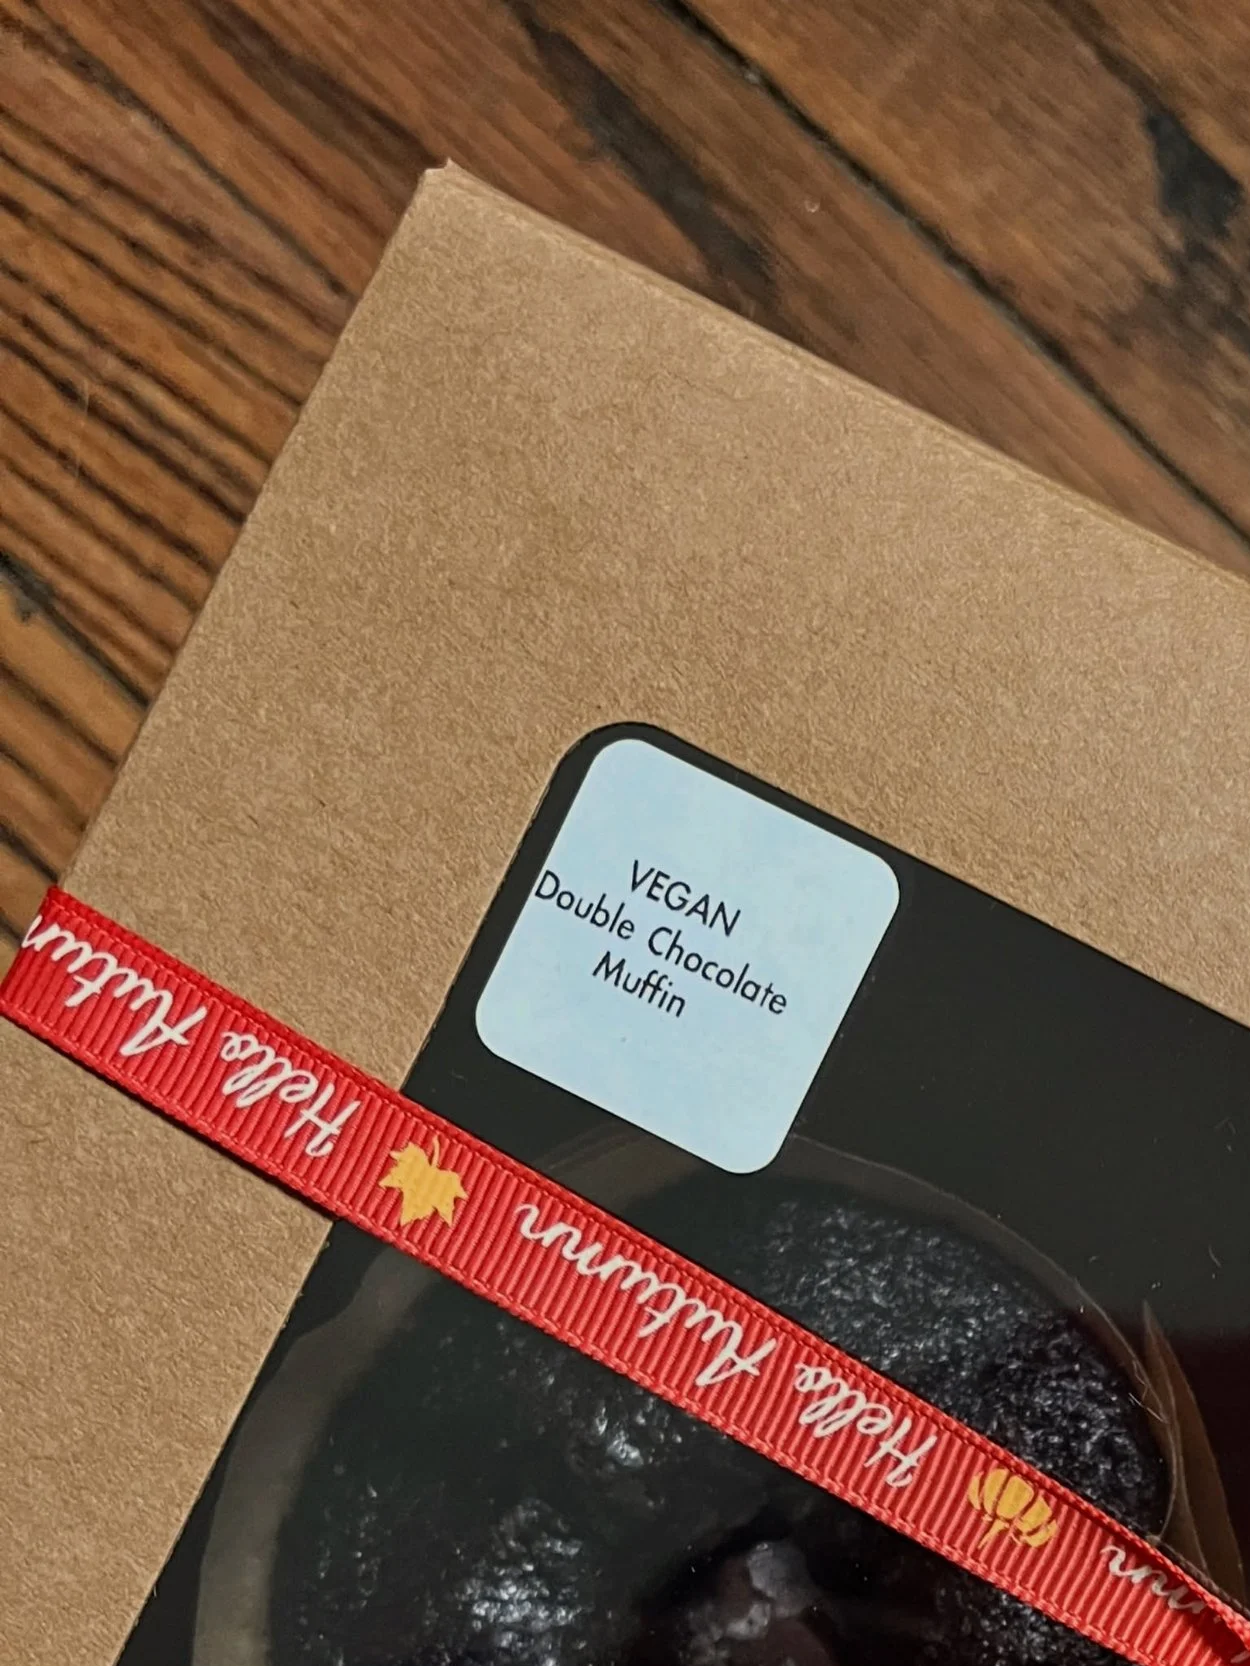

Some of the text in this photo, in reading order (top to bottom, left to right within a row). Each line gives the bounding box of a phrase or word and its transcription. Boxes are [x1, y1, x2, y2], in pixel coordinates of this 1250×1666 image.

[534, 869, 788, 1015] Double Chocolate
[629, 859, 742, 937] VEGAN
[592, 951, 686, 1018] Muffin
[221, 1031, 362, 1158] Hello
[516, 1202, 938, 1488] Hello Autumn
